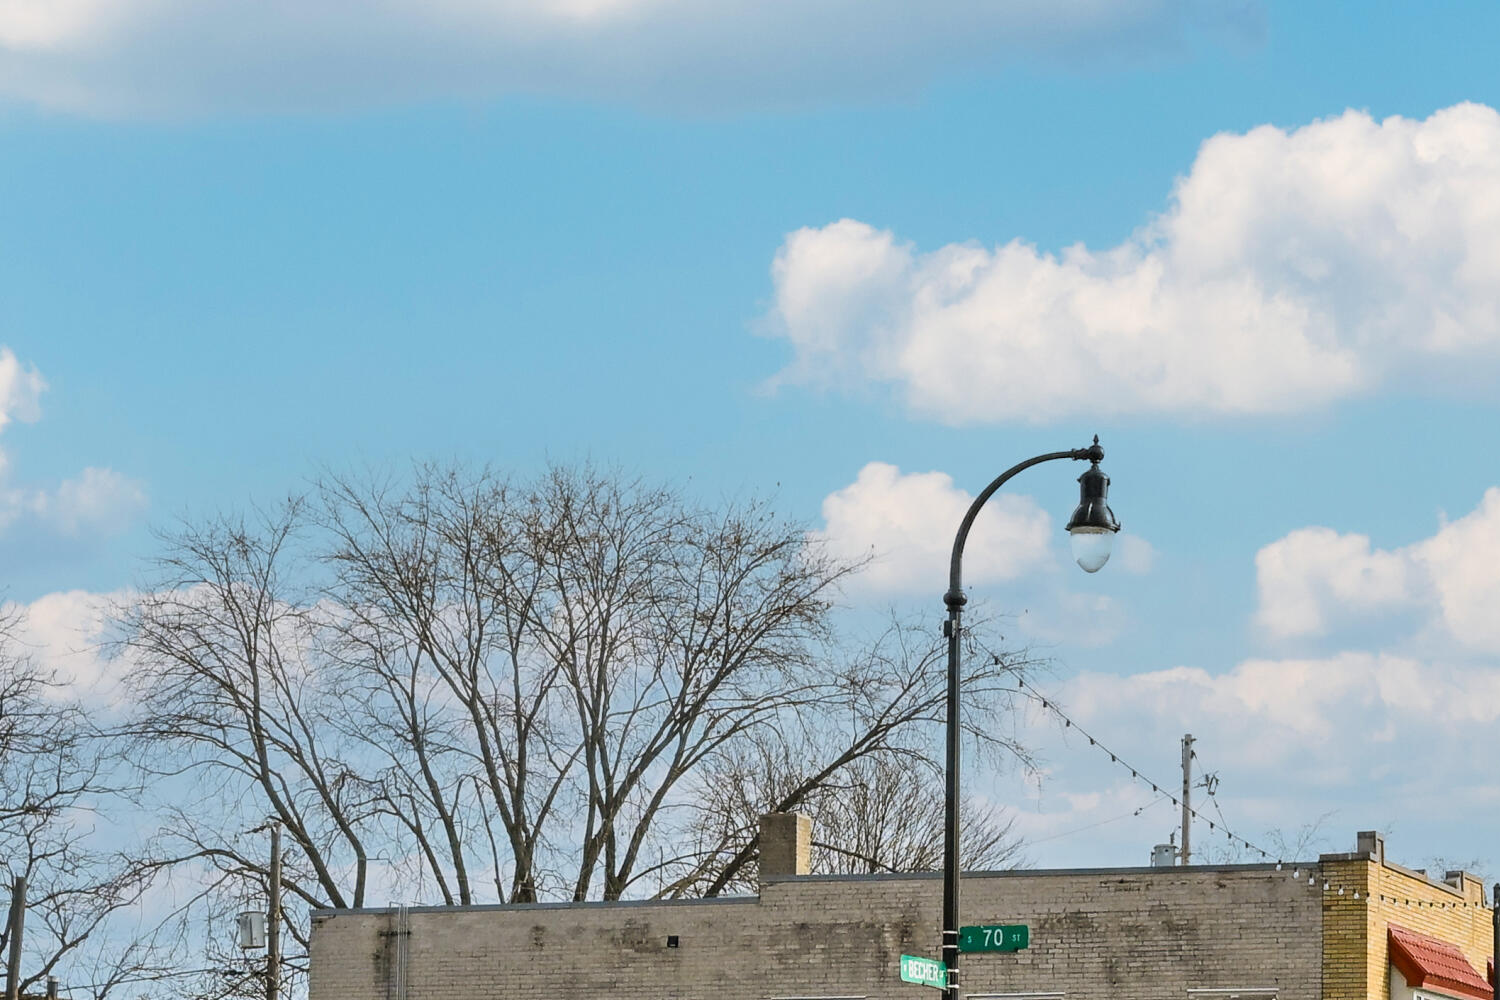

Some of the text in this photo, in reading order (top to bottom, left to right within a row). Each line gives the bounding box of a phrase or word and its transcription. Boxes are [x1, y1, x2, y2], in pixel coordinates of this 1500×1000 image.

[967, 928, 1021, 947] S 70 ST
[908, 959, 939, 982] BECHER
